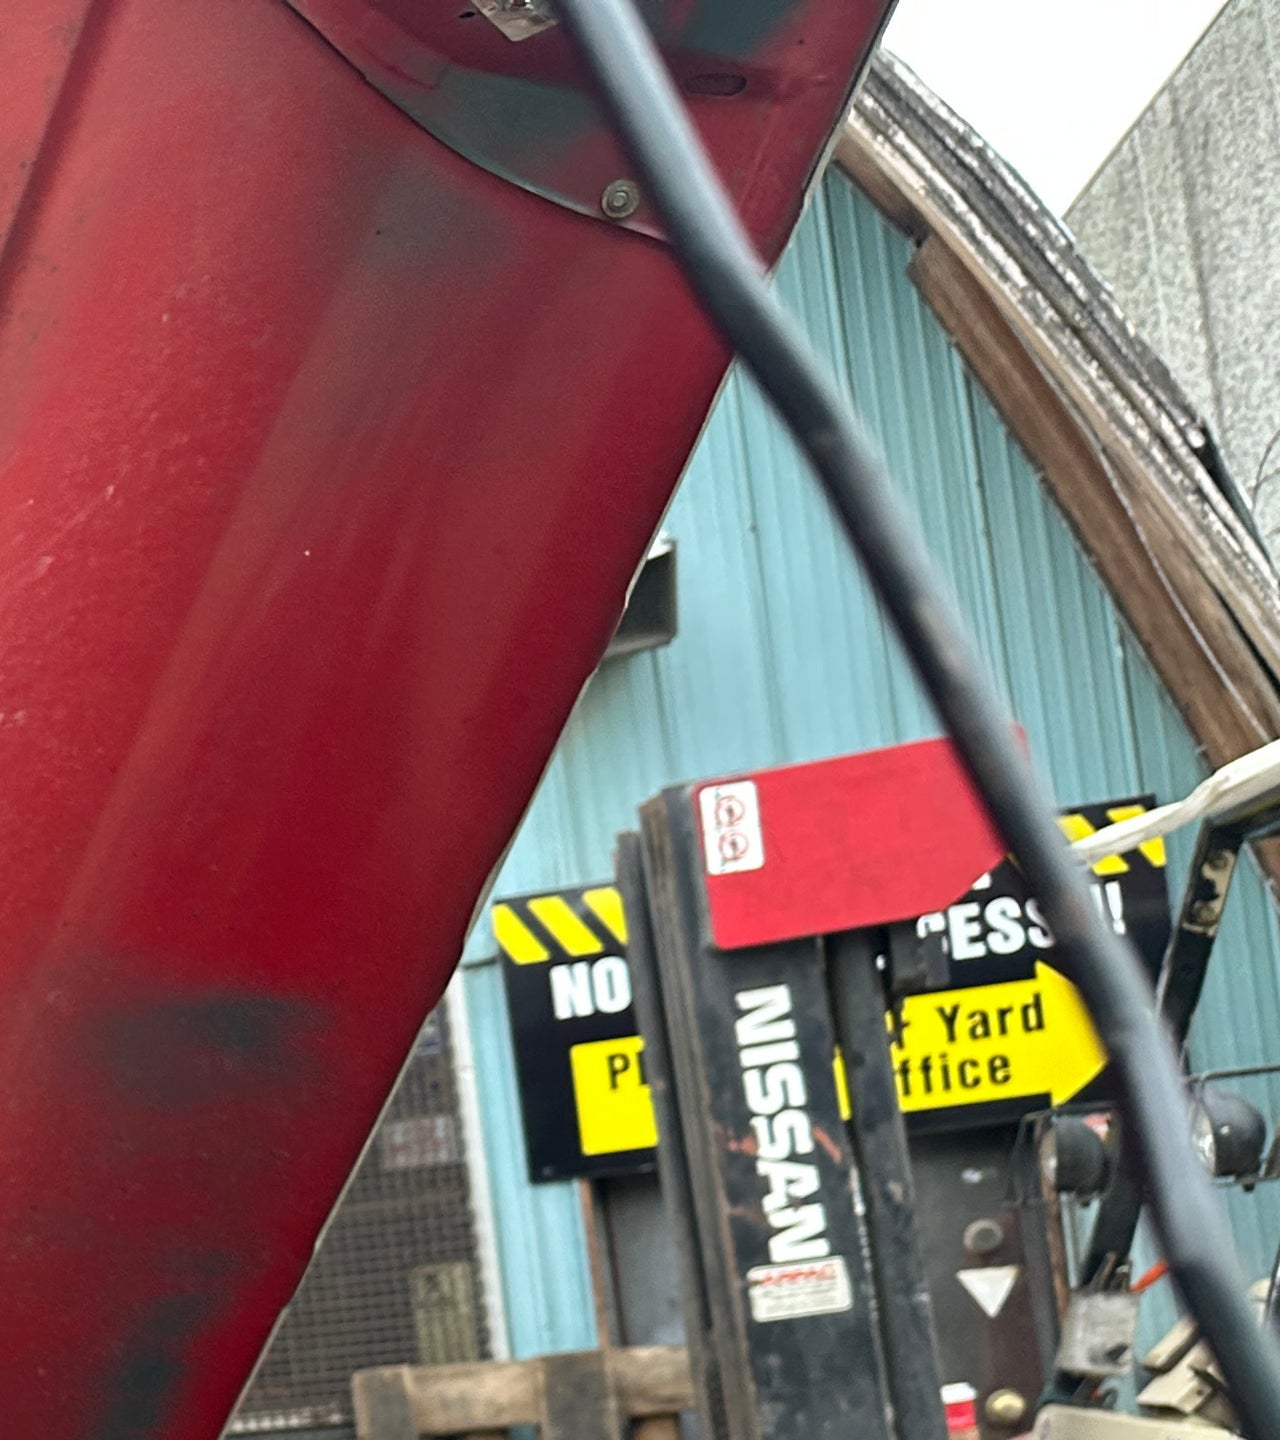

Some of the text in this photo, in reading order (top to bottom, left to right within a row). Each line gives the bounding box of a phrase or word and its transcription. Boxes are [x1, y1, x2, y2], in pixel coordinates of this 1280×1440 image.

[549, 956, 633, 1021] NO
[936, 992, 1045, 1043] Yard
[894, 1052, 1012, 1097] ffice
[734, 983, 831, 1264] NISSAN
